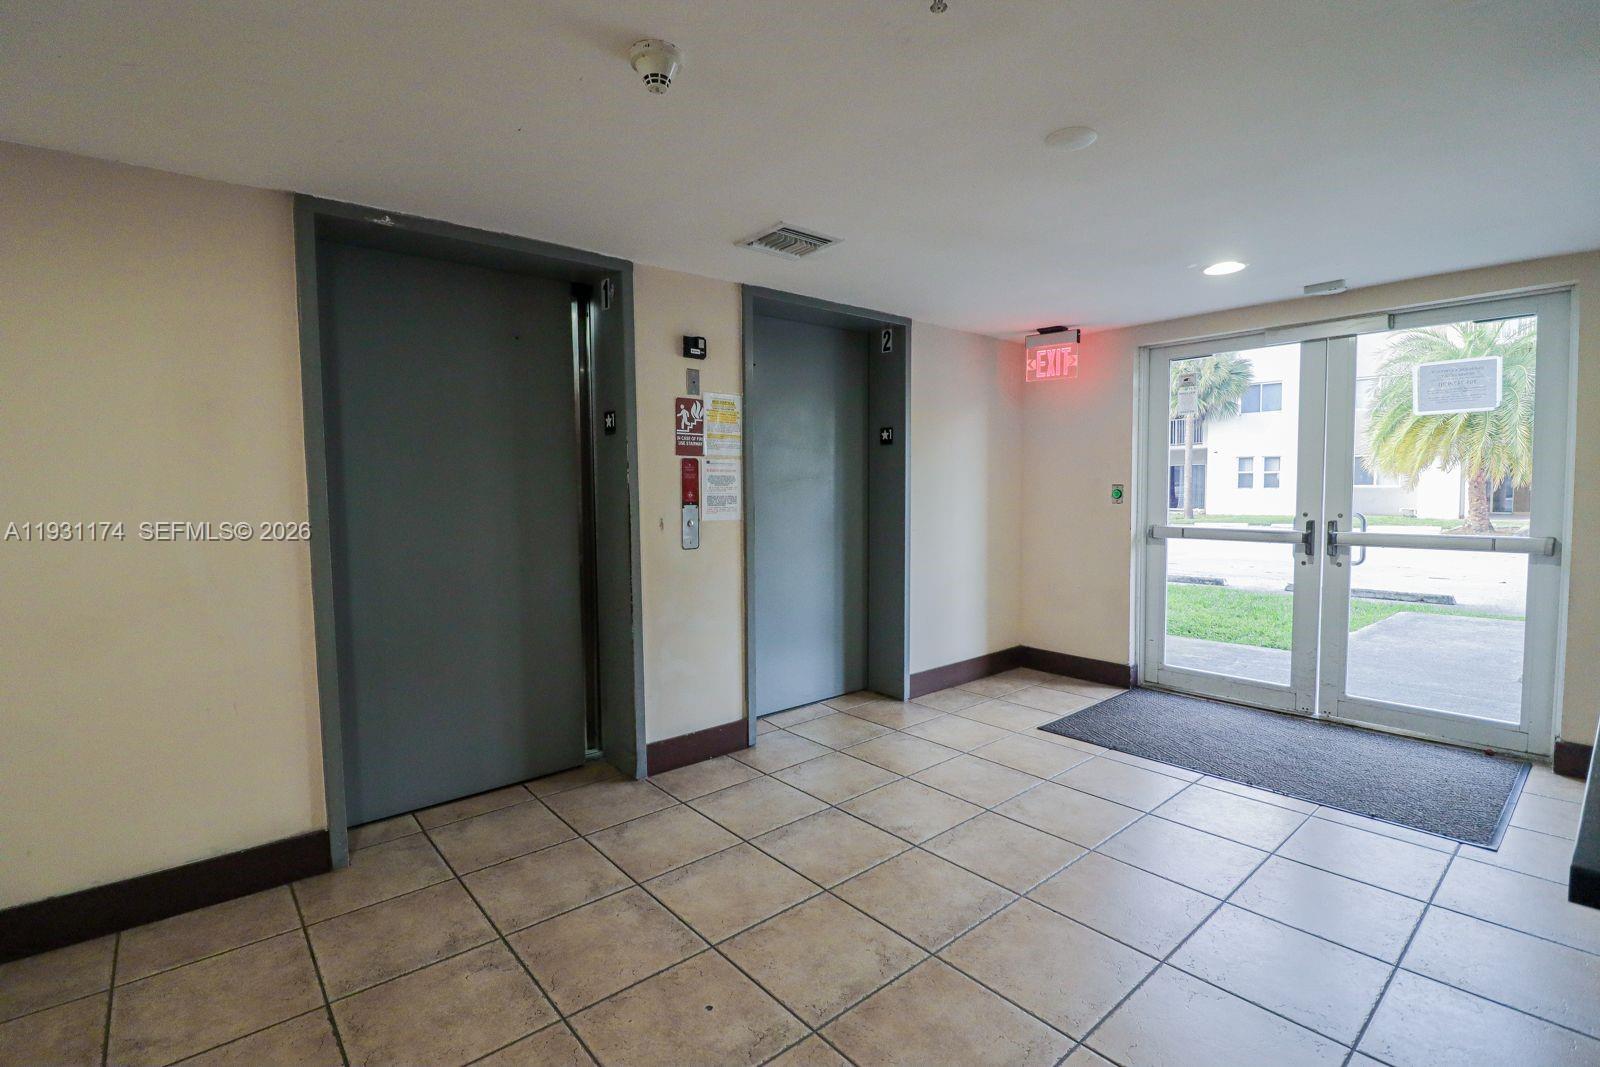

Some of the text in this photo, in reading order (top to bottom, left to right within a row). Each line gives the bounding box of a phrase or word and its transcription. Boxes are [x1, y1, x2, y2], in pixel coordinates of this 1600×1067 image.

[602, 279, 609, 309] 1
[882, 329, 892, 352] 2
[1036, 347, 1072, 378] EXIT
